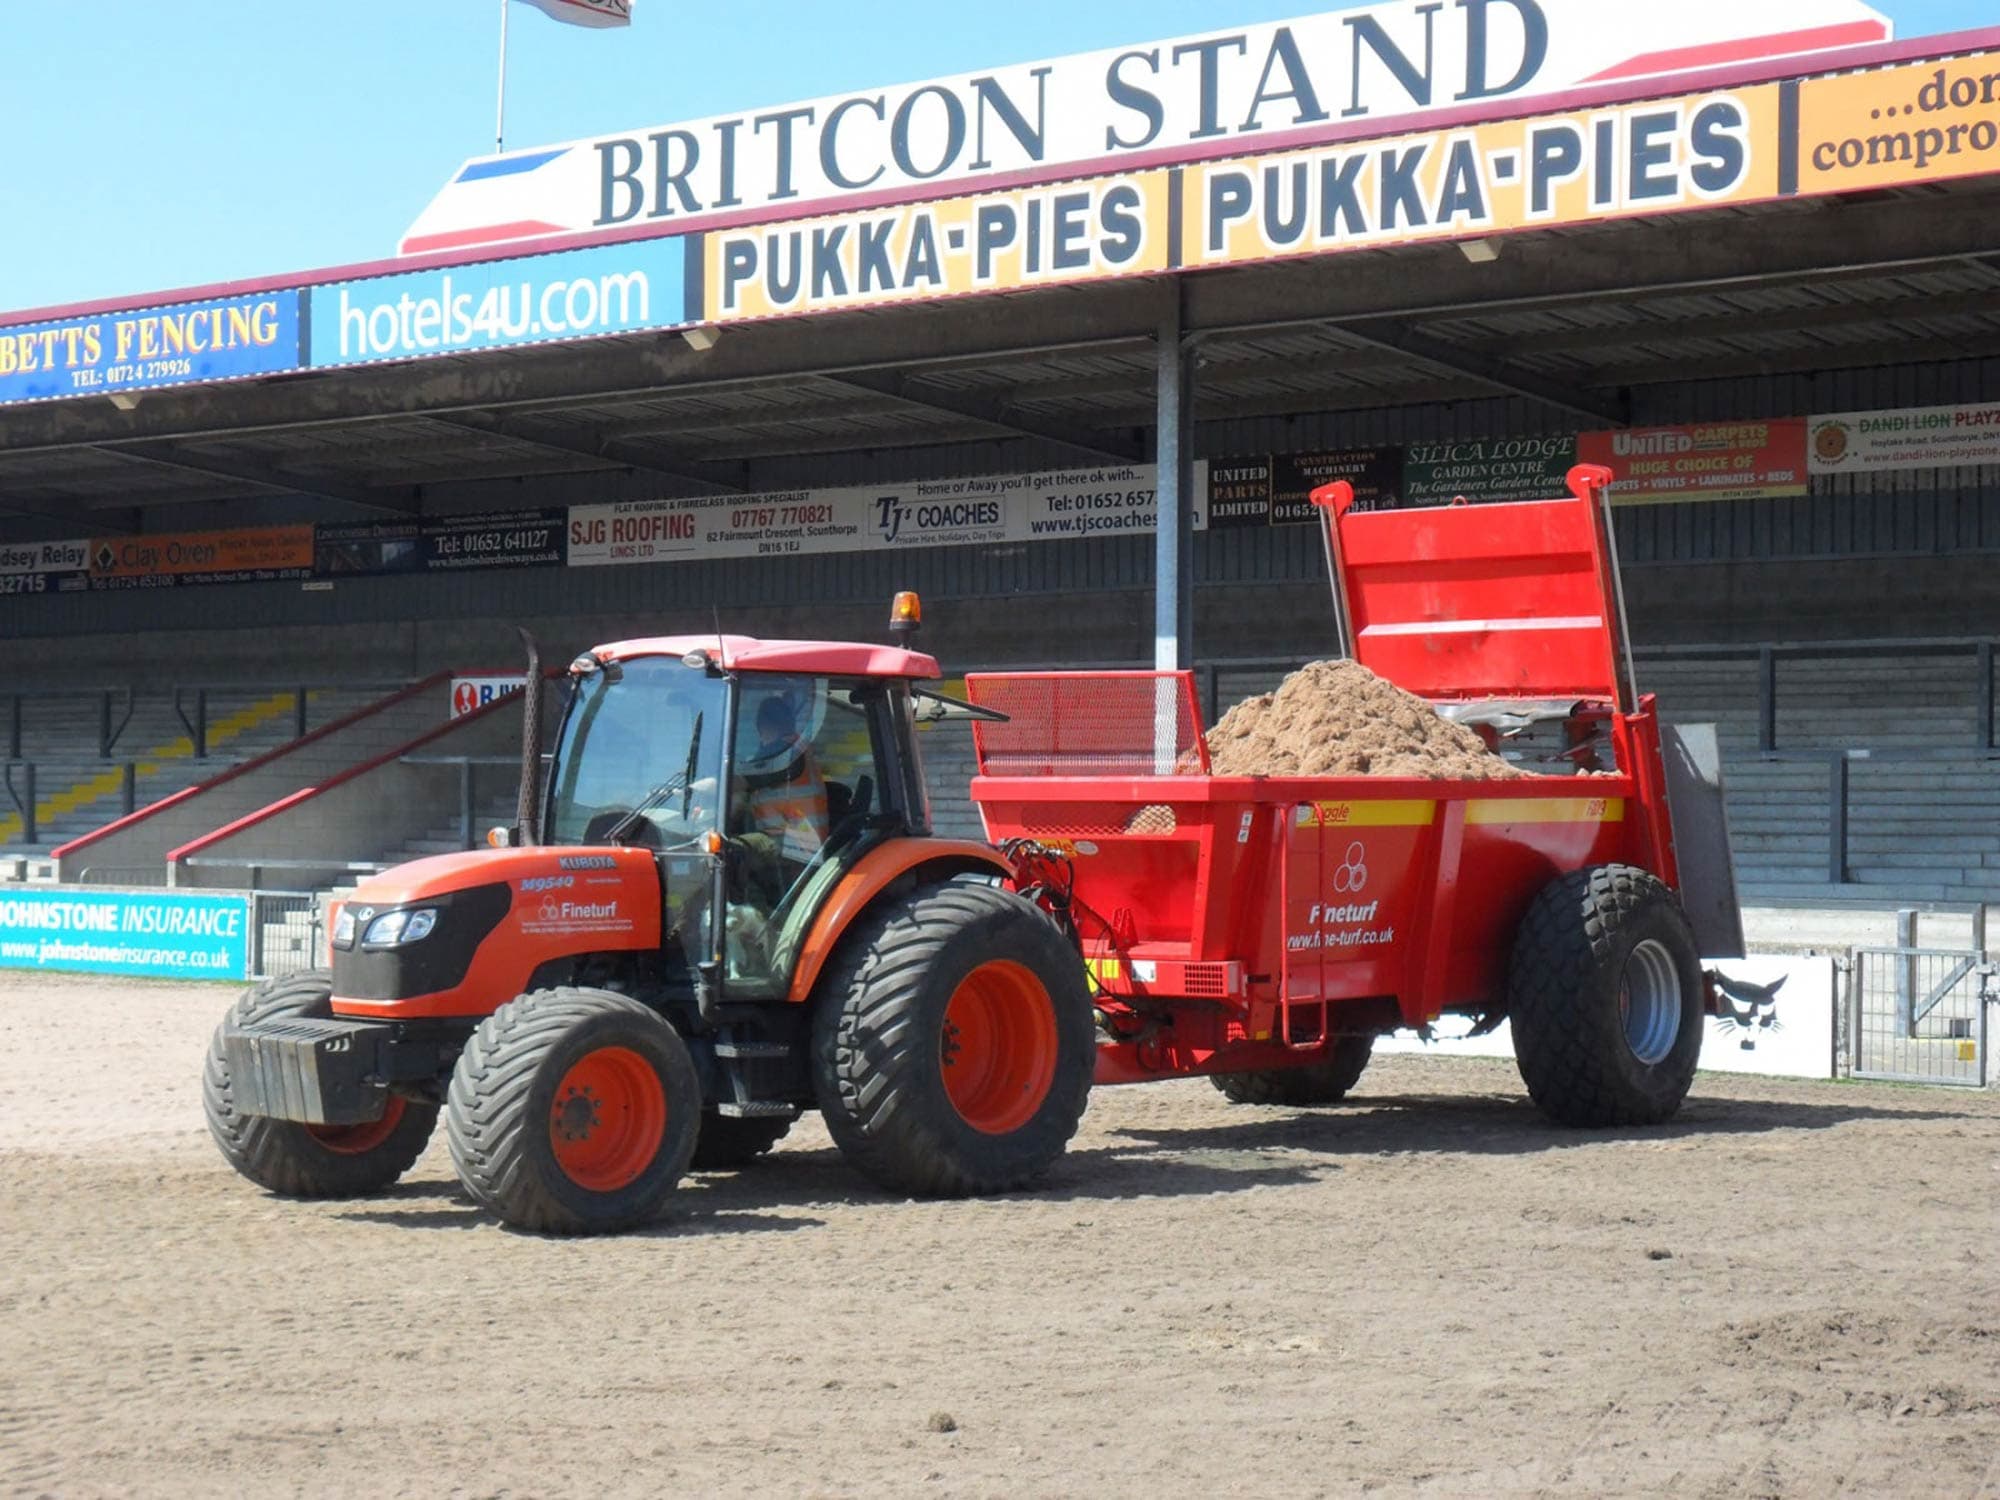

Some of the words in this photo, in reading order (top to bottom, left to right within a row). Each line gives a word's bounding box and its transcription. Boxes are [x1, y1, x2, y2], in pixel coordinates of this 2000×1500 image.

[592, 66, 1052, 228] BRITCON
[1105, 0, 1550, 151] STAND
[1208, 102, 1743, 251] PUKKA-PIES
[723, 186, 1142, 309] PUKKA-PIES
[0, 324, 102, 376] BETTS
[115, 301, 280, 363] FENCING
[71, 370, 104, 388] TEL:
[107, 365, 143, 384] 01724
[147, 359, 192, 380] 279926
[1694, 424, 1768, 441] CARPETS
[1859, 415, 1909, 433] DANDI
[1914, 413, 1950, 430] LION
[1490, 436, 1575, 460] LODGE
[1213, 466, 1268, 482] UNITED
[1303, 463, 1367, 475] MACHINERY
[1432, 464, 1488, 480] GARDEN
[1491, 461, 1547, 476] CENTRE
[1630, 460, 1670, 475] HUGE
[1675, 457, 1728, 473] CHOICE
[1733, 454, 1755, 469] OF
[917, 483, 950, 495] Home
[953, 483, 964, 493] or
[967, 480, 998, 493] Away
[1000, 476, 1031, 492] you'll
[1034, 474, 1054, 489] get
[1056, 473, 1088, 485] there
[1090, 470, 1106, 484] ok
[1214, 485, 1267, 499] PARTS
[1408, 481, 1429, 495] The
[1490, 475, 1532, 490] Garden
[1534, 473, 1566, 488] Centr
[614, 503, 632, 513] FLAT
[634, 501, 667, 512] ROOFING
[764, 492, 810, 503] SPECIALIST
[1046, 495, 1073, 512] Tel:
[1075, 492, 1122, 510] 01652
[1126, 490, 1158, 507] 657
[1212, 500, 1269, 517] LIMITED
[732, 508, 775, 528] 07767
[781, 504, 833, 525] 770821
[917, 502, 999, 528] COACHES
[571, 519, 606, 545] SJG
[612, 513, 695, 543] ROOFING
[765, 527, 805, 539] Crescent,
[807, 524, 858, 537] Scunthorpe
[435, 536, 460, 554] Tel:
[463, 532, 501, 553] 01652
[504, 529, 549, 550] 641127
[610, 545, 636, 558] LINCS
[638, 544, 655, 557] LTD
[42, 546, 85, 567] Relay
[122, 544, 160, 567] Clay
[167, 542, 214, 565] Oven
[559, 855, 618, 870] KUBOTA
[121, 903, 241, 937] INSURANCE
[561, 901, 617, 919] Fineturf
[1309, 900, 1379, 924] Fneturf
[1, 937, 231, 969] www.johnstoneinsurance.co.uk
